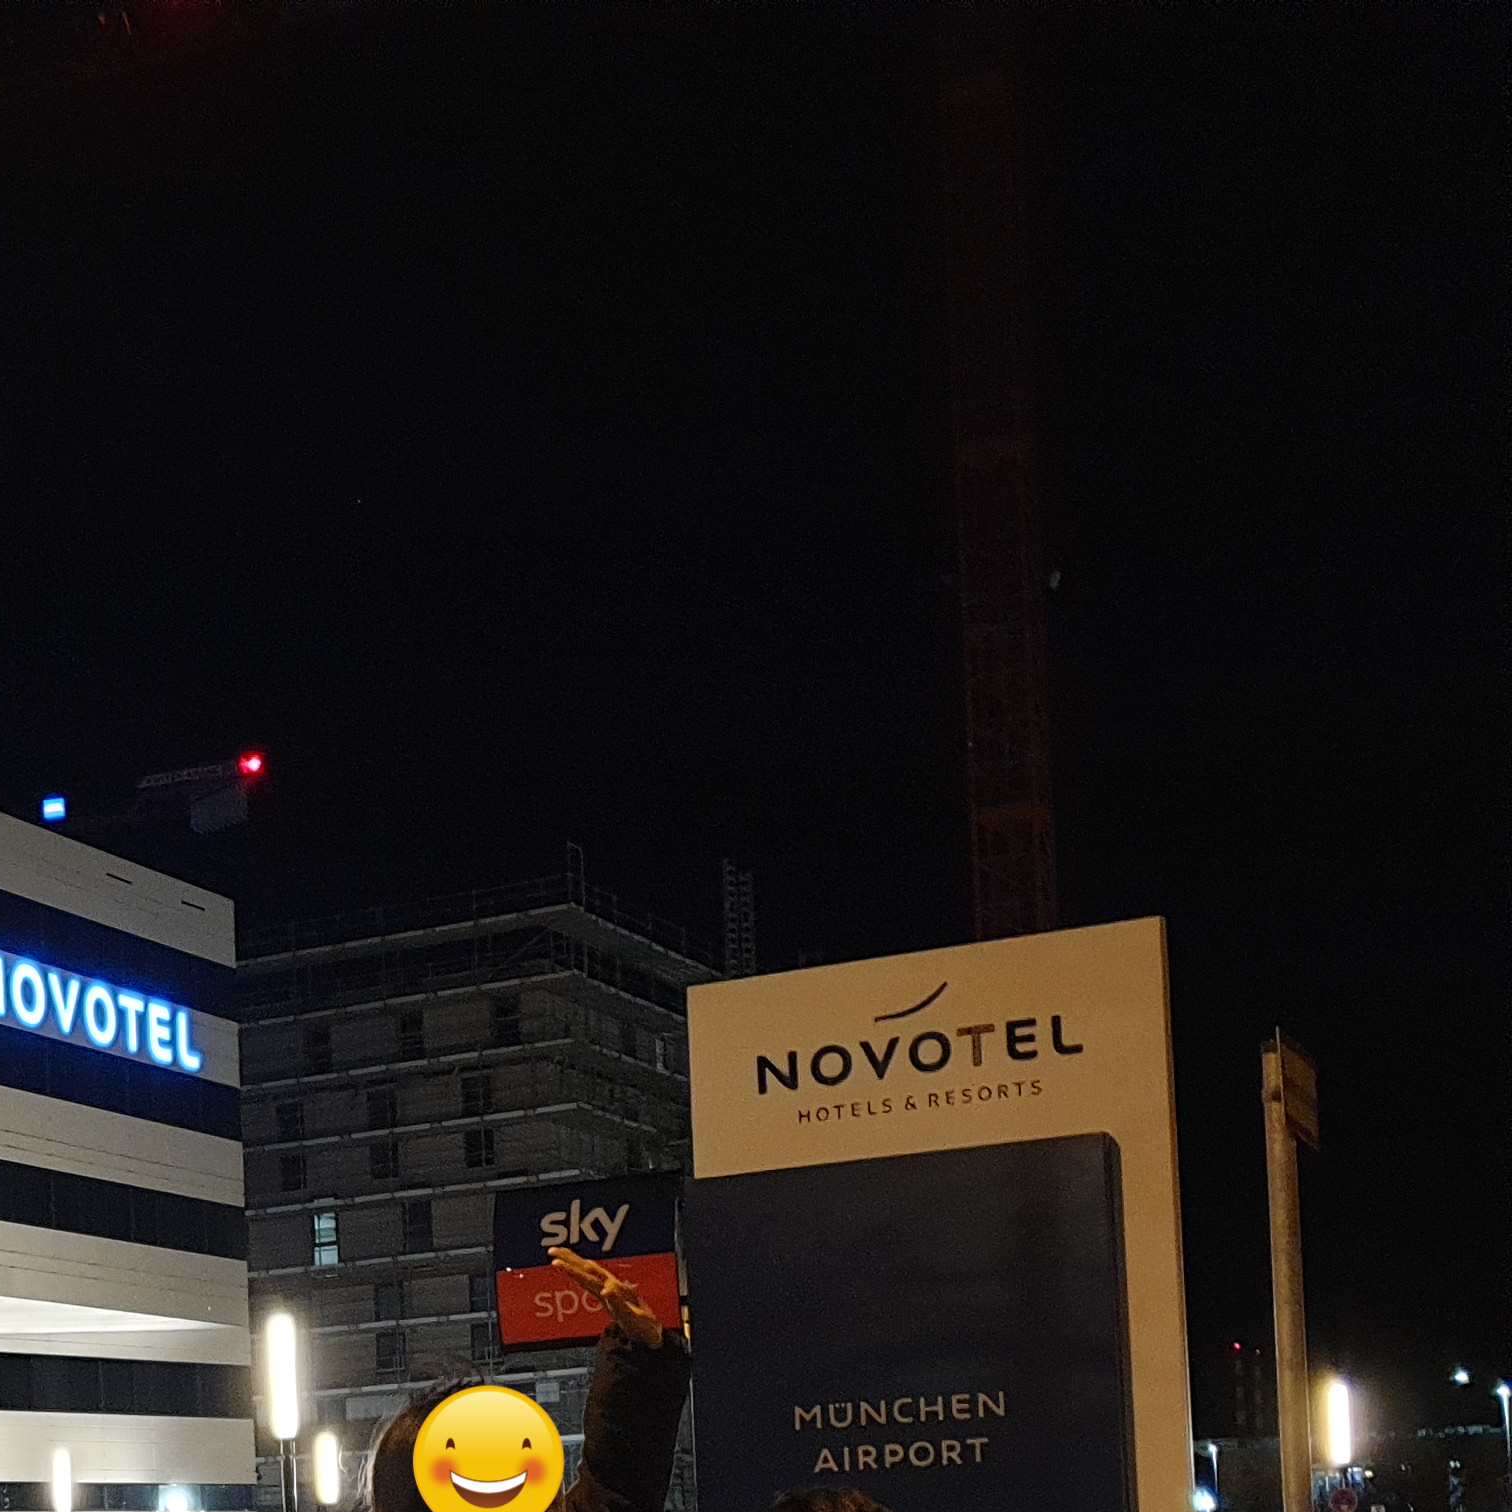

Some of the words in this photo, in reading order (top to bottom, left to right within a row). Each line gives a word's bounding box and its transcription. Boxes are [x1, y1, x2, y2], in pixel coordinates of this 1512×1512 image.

[755, 1014, 1085, 1095] NOVOTEL
[797, 1098, 893, 1124] HOTELS
[903, 1094, 919, 1111] &
[927, 1079, 1044, 1109] RESORTS
[539, 1199, 630, 1252] sky
[533, 1289, 604, 1323] spo
[793, 1390, 1006, 1431] MÜNCHEN
[813, 1437, 989, 1473] AIRPORT
